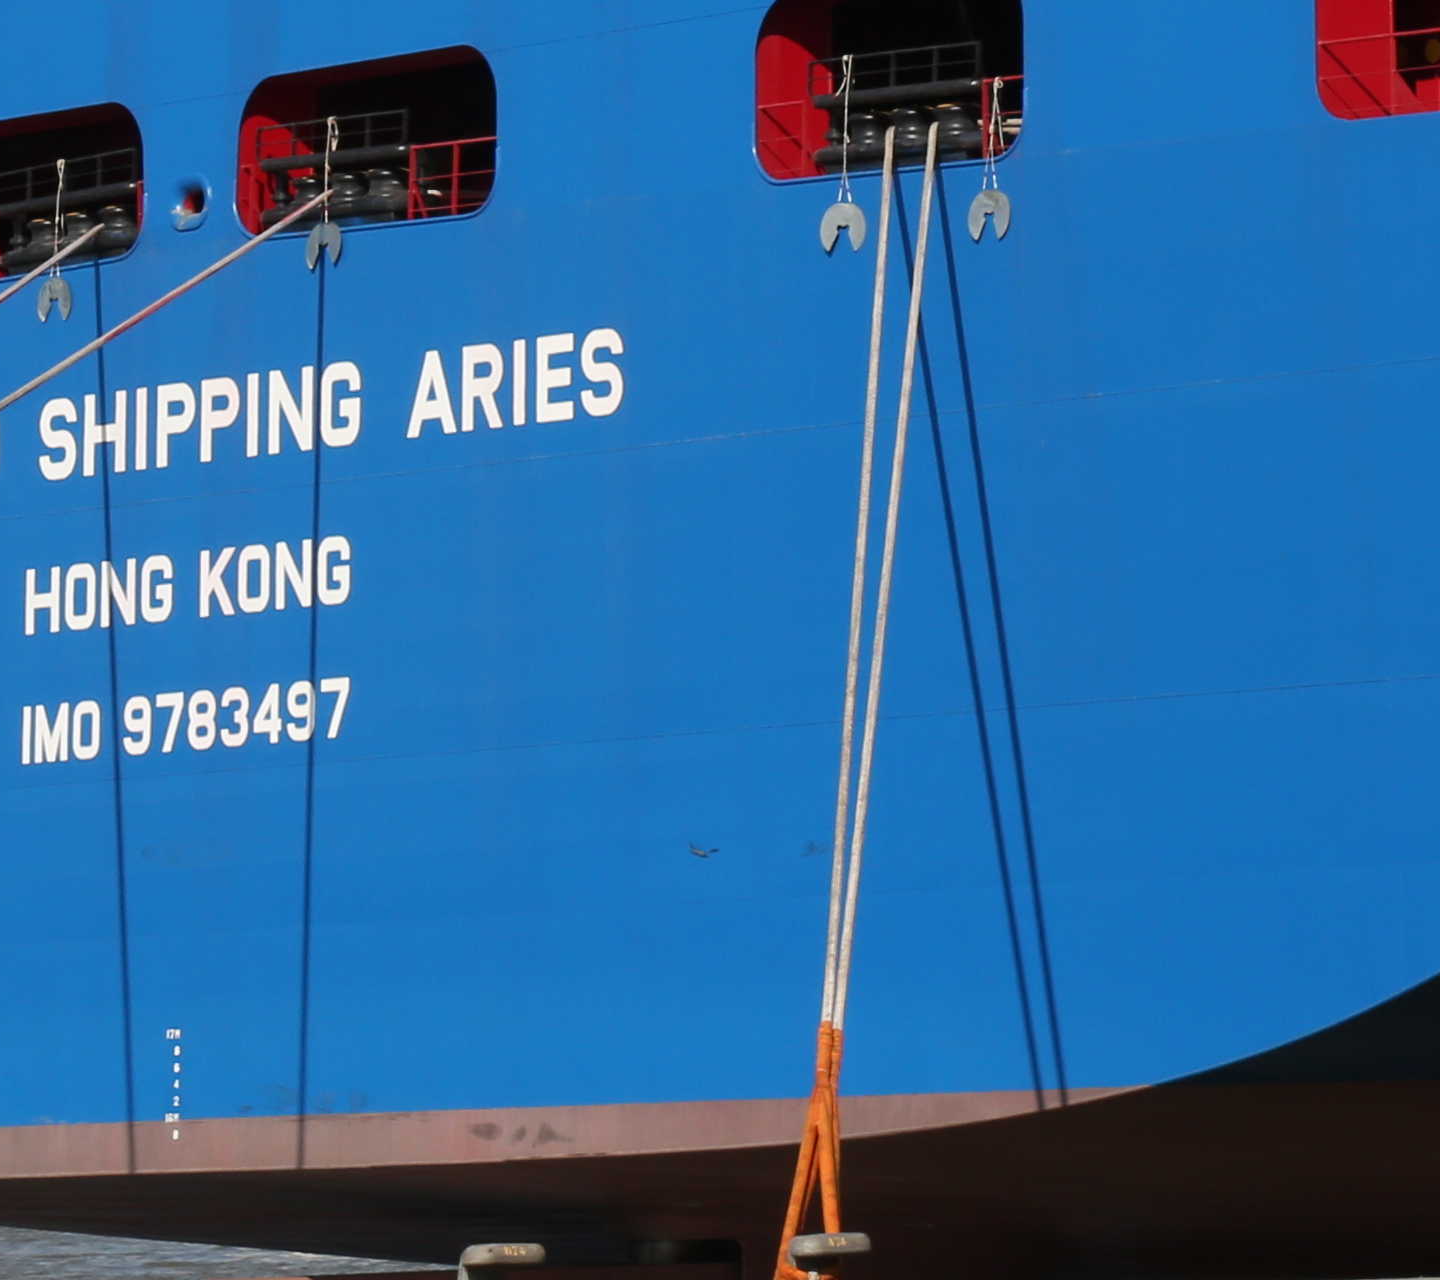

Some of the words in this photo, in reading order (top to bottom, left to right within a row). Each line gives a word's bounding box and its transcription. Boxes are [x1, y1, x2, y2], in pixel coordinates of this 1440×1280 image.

[38, 360, 362, 482] SHIPPING
[406, 327, 624, 439] ARIES
[23, 553, 174, 636] HONG
[198, 535, 352, 618] KONG
[20, 699, 101, 766] IMO
[123, 676, 351, 757] 9783497
